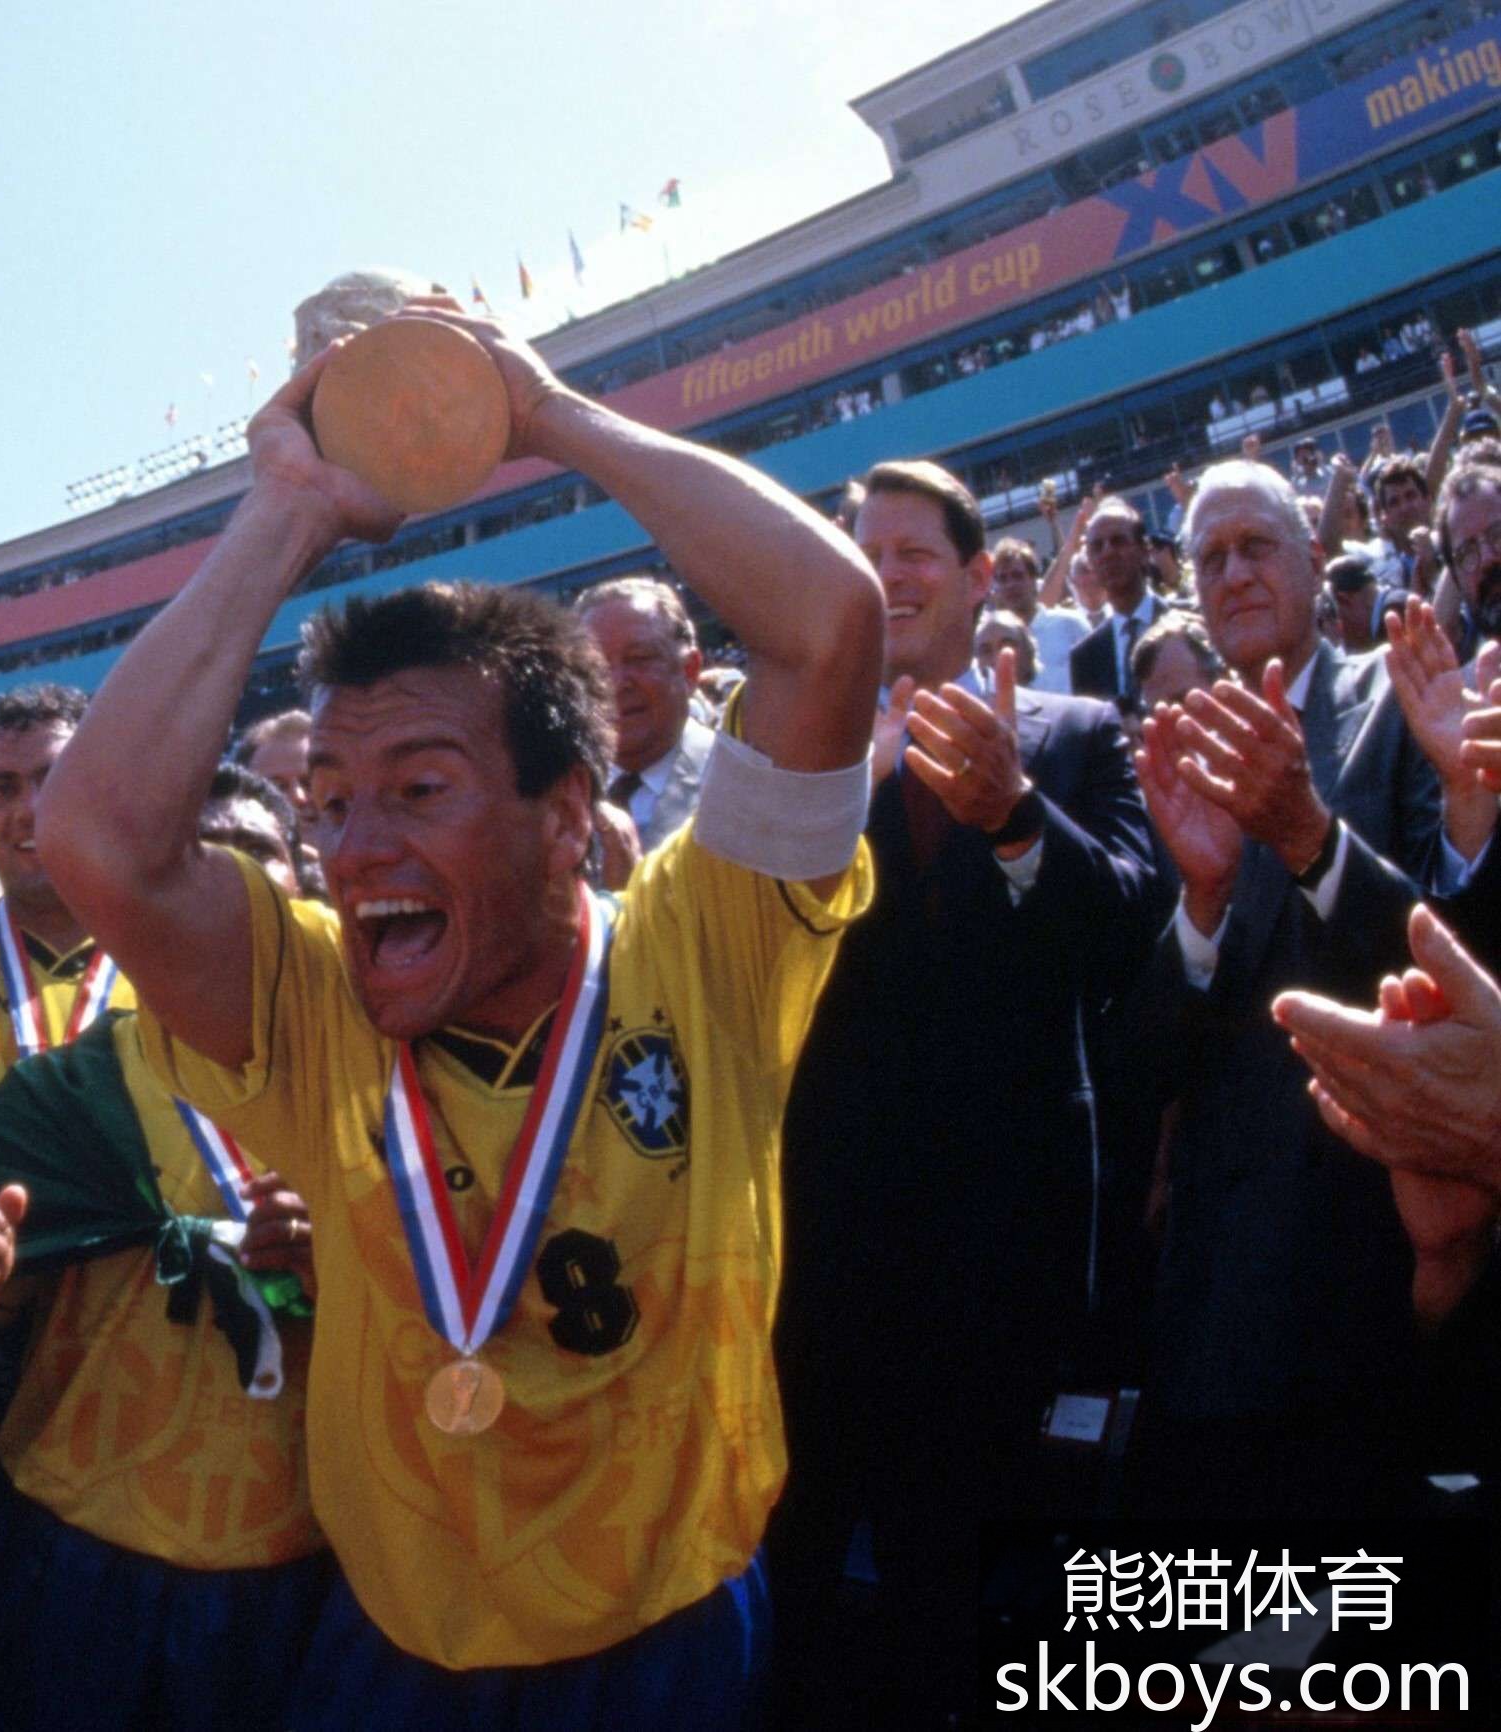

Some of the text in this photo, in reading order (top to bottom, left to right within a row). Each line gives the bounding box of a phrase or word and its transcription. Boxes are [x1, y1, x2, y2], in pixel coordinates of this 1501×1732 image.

[1011, 0, 1334, 156] ROSE BOWL
[1365, 38, 1501, 130] making
[1101, 108, 1297, 260] XV
[681, 241, 1042, 408] fifteenth world cup
[537, 1227, 641, 1358] 8
